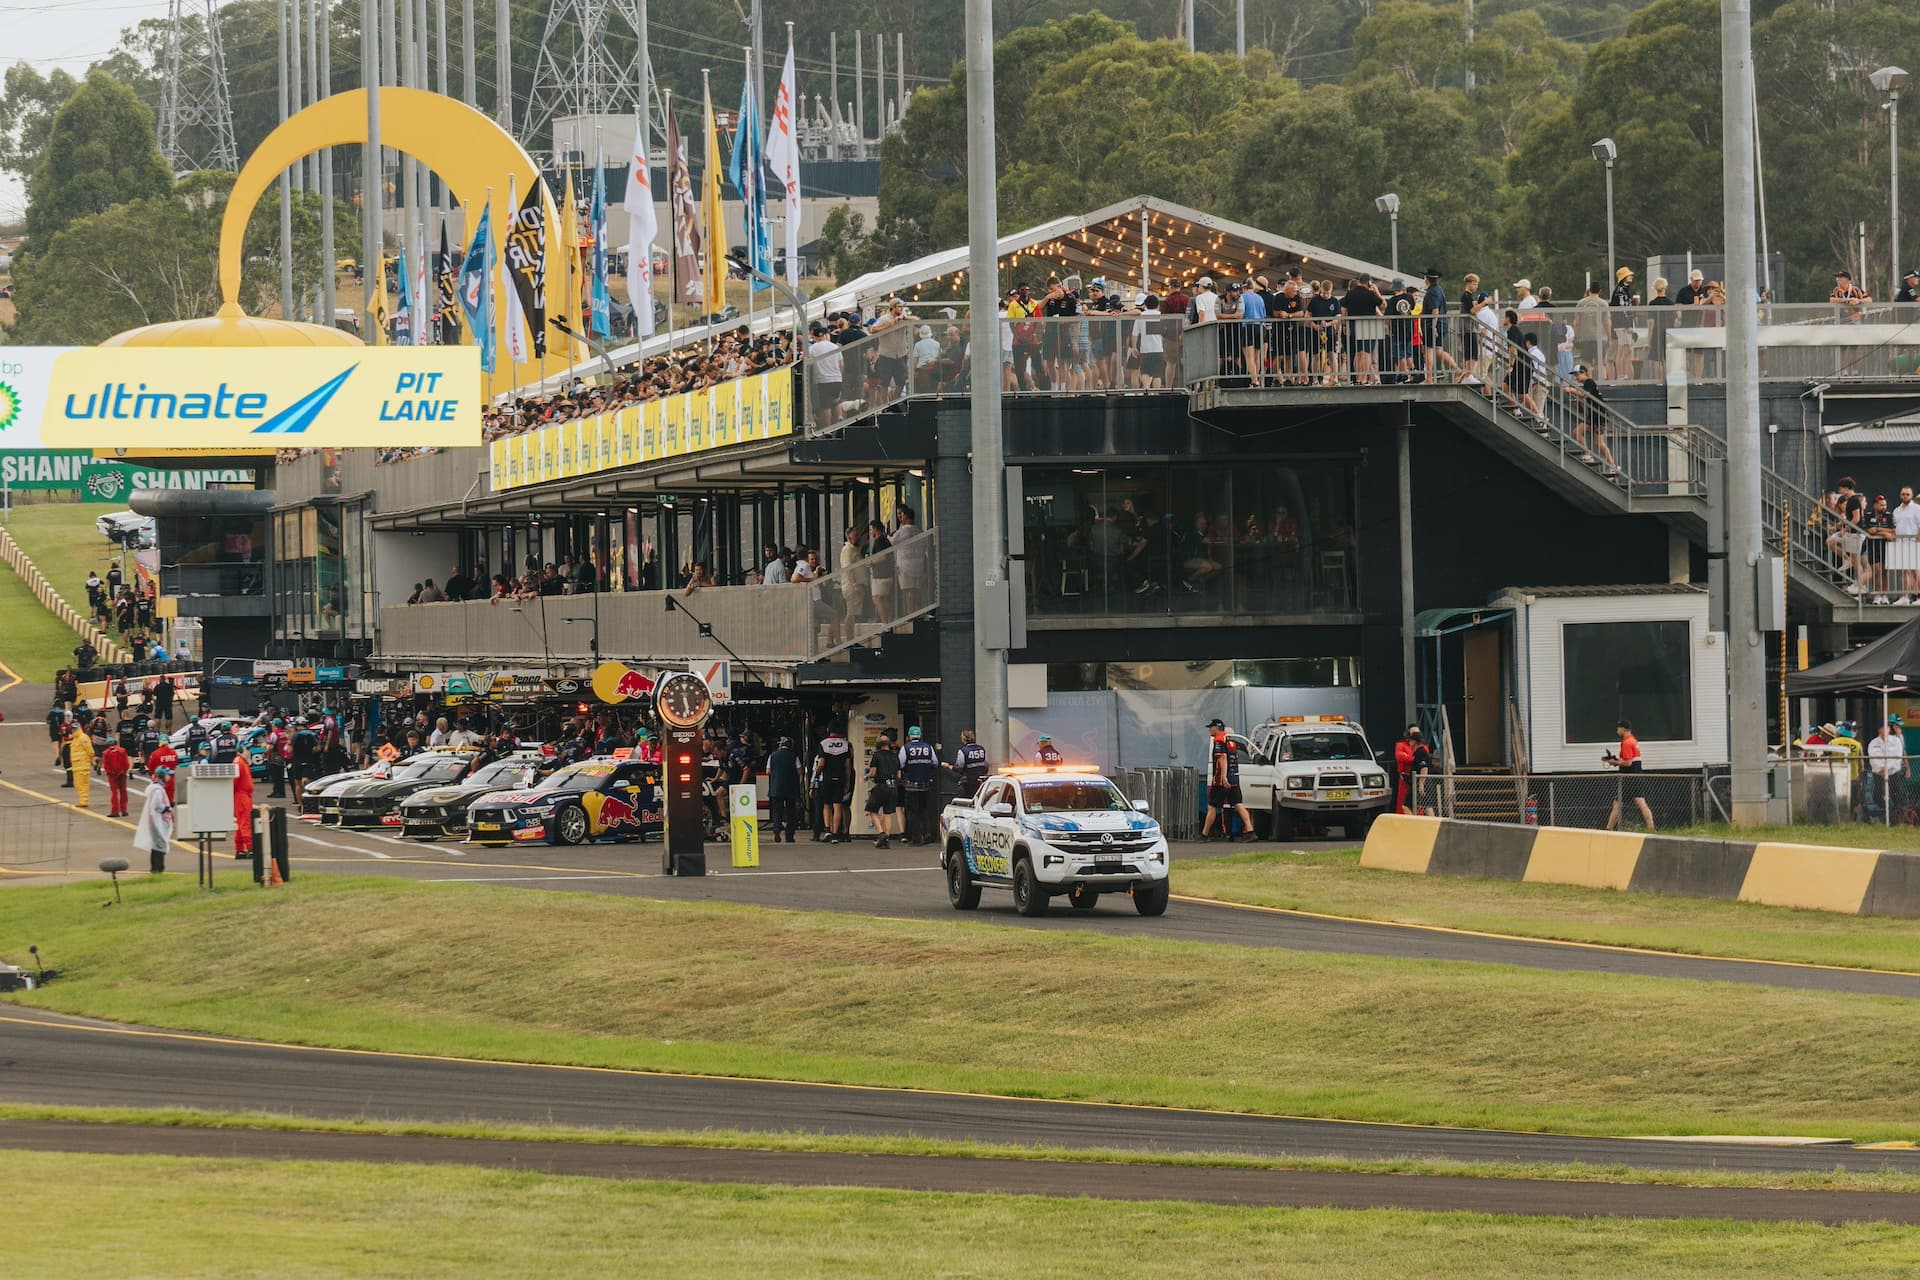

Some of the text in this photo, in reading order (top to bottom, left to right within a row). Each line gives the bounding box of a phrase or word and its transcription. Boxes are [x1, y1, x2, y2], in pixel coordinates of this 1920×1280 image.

[2, 361, 23, 376] bp
[396, 373, 443, 393] PIT
[65, 383, 268, 419] ultimate
[379, 400, 459, 421] LANE
[909, 747, 929, 757] 376
[968, 749, 985, 760] 456
[973, 829, 1010, 849] AMAROK
